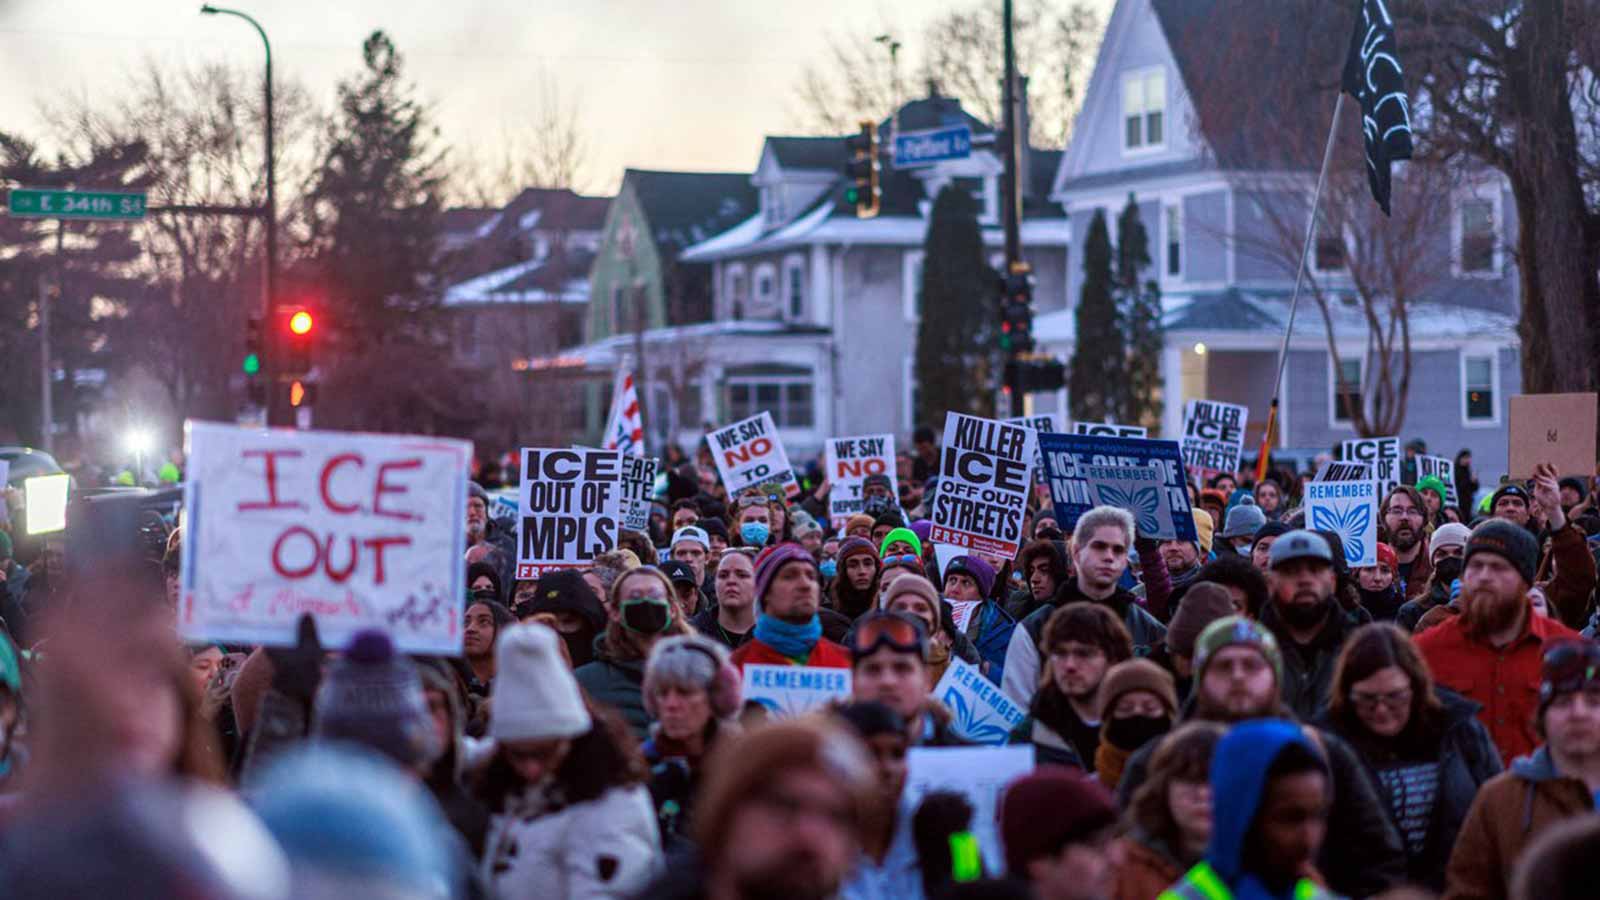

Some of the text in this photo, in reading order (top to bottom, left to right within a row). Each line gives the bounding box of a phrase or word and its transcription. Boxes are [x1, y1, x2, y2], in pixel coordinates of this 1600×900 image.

[41, 195, 52, 211] E
[1194, 402, 1240, 428] KILLER
[716, 417, 766, 450] WE SAY
[954, 416, 1026, 462] KILLER
[1187, 420, 1241, 444] ICE
[724, 438, 772, 468] NO
[835, 438, 884, 459] WE SAY
[1182, 446, 1237, 471] STREETS
[1347, 440, 1397, 461] ICE
[527, 450, 618, 481] ICE
[741, 464, 769, 481] TO
[838, 459, 886, 478] NO
[944, 448, 1027, 494] ICE
[1047, 452, 1085, 479] ICE
[1090, 467, 1157, 481] REMEMBER
[1322, 463, 1365, 481] KILLER
[1378, 460, 1393, 480] OF
[530, 481, 575, 513] OUT
[581, 482, 610, 514] OF
[941, 481, 1023, 508] OFF OUR
[1310, 484, 1372, 499] REMEMBER
[935, 494, 1020, 541] STREETS
[522, 517, 615, 560] MPLS
[934, 529, 969, 546] FRSO
[271, 525, 412, 585] OUT
[752, 669, 845, 691] REMEMBER
[953, 664, 1025, 725] REMEMBER
